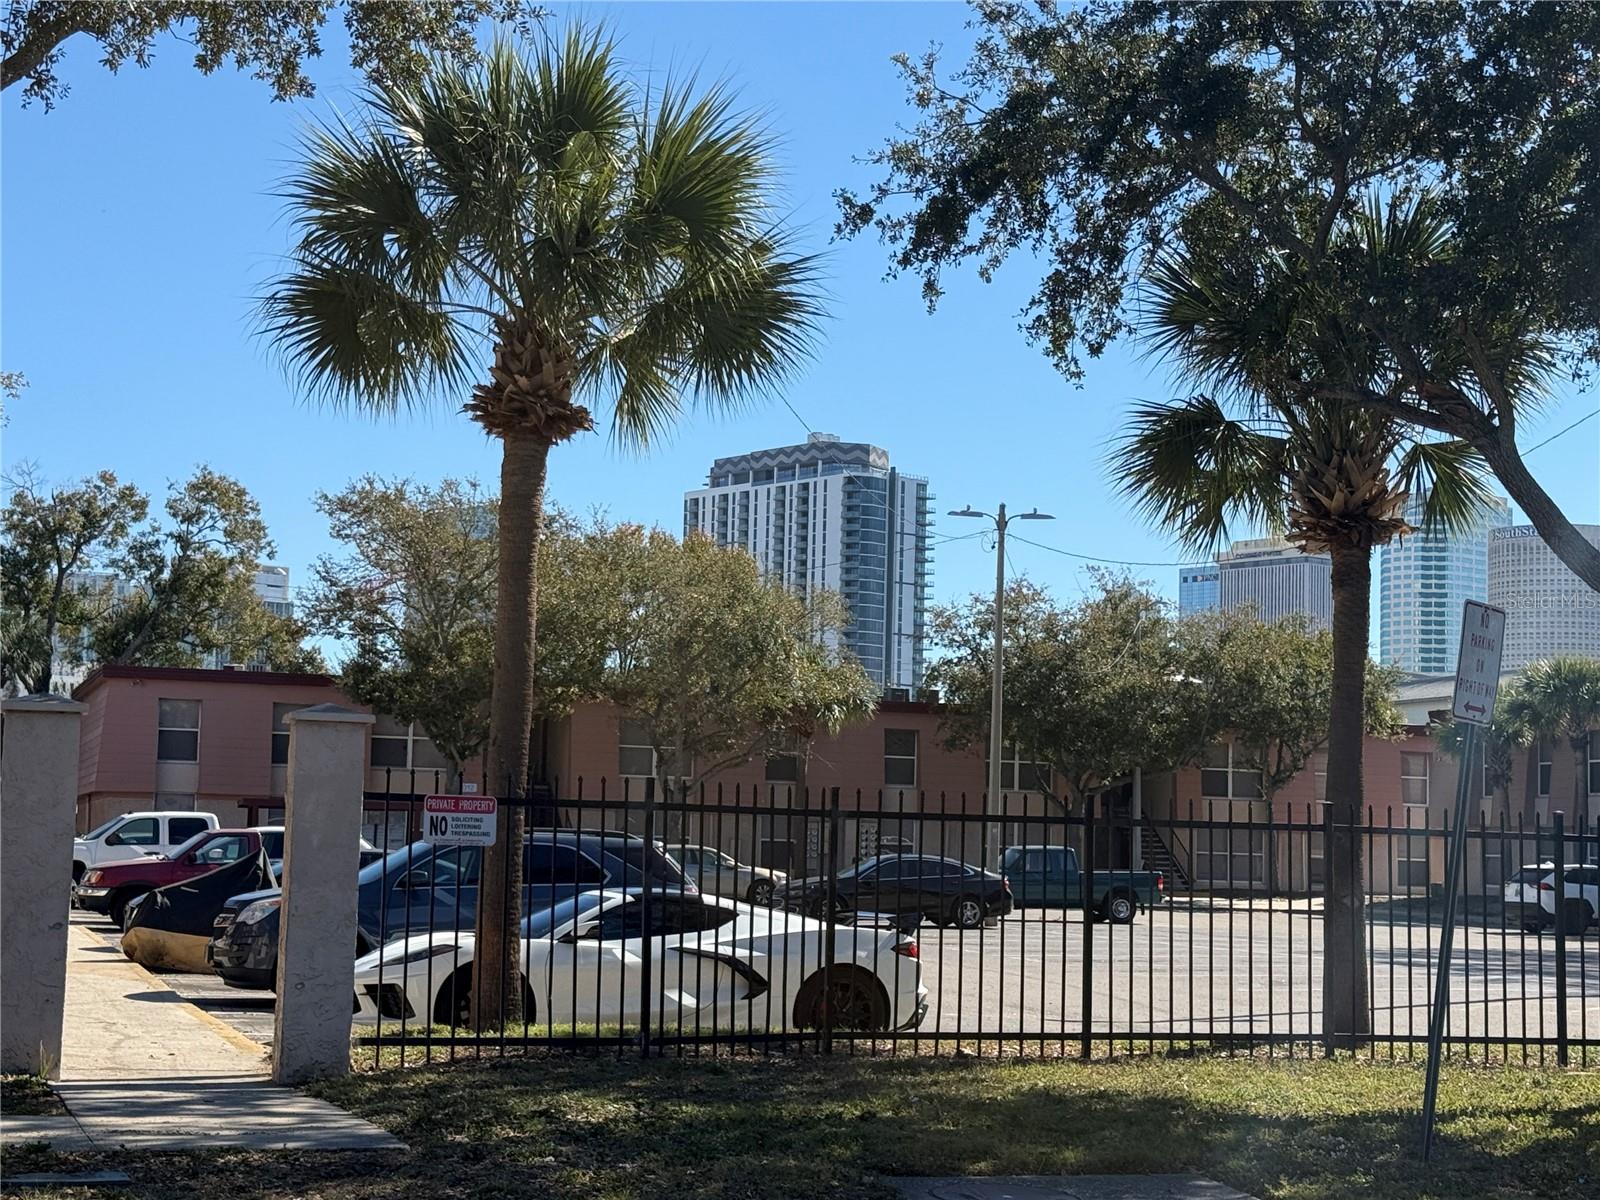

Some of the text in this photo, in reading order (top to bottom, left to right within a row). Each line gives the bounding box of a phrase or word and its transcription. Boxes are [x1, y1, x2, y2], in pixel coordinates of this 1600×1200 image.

[1480, 612, 1490, 629] NO
[1470, 633, 1496, 652] PARKING
[427, 798, 494, 811] PRIVATE PROPERTY
[429, 815, 448, 837] NO
[450, 830, 491, 838] TRESPASSING
